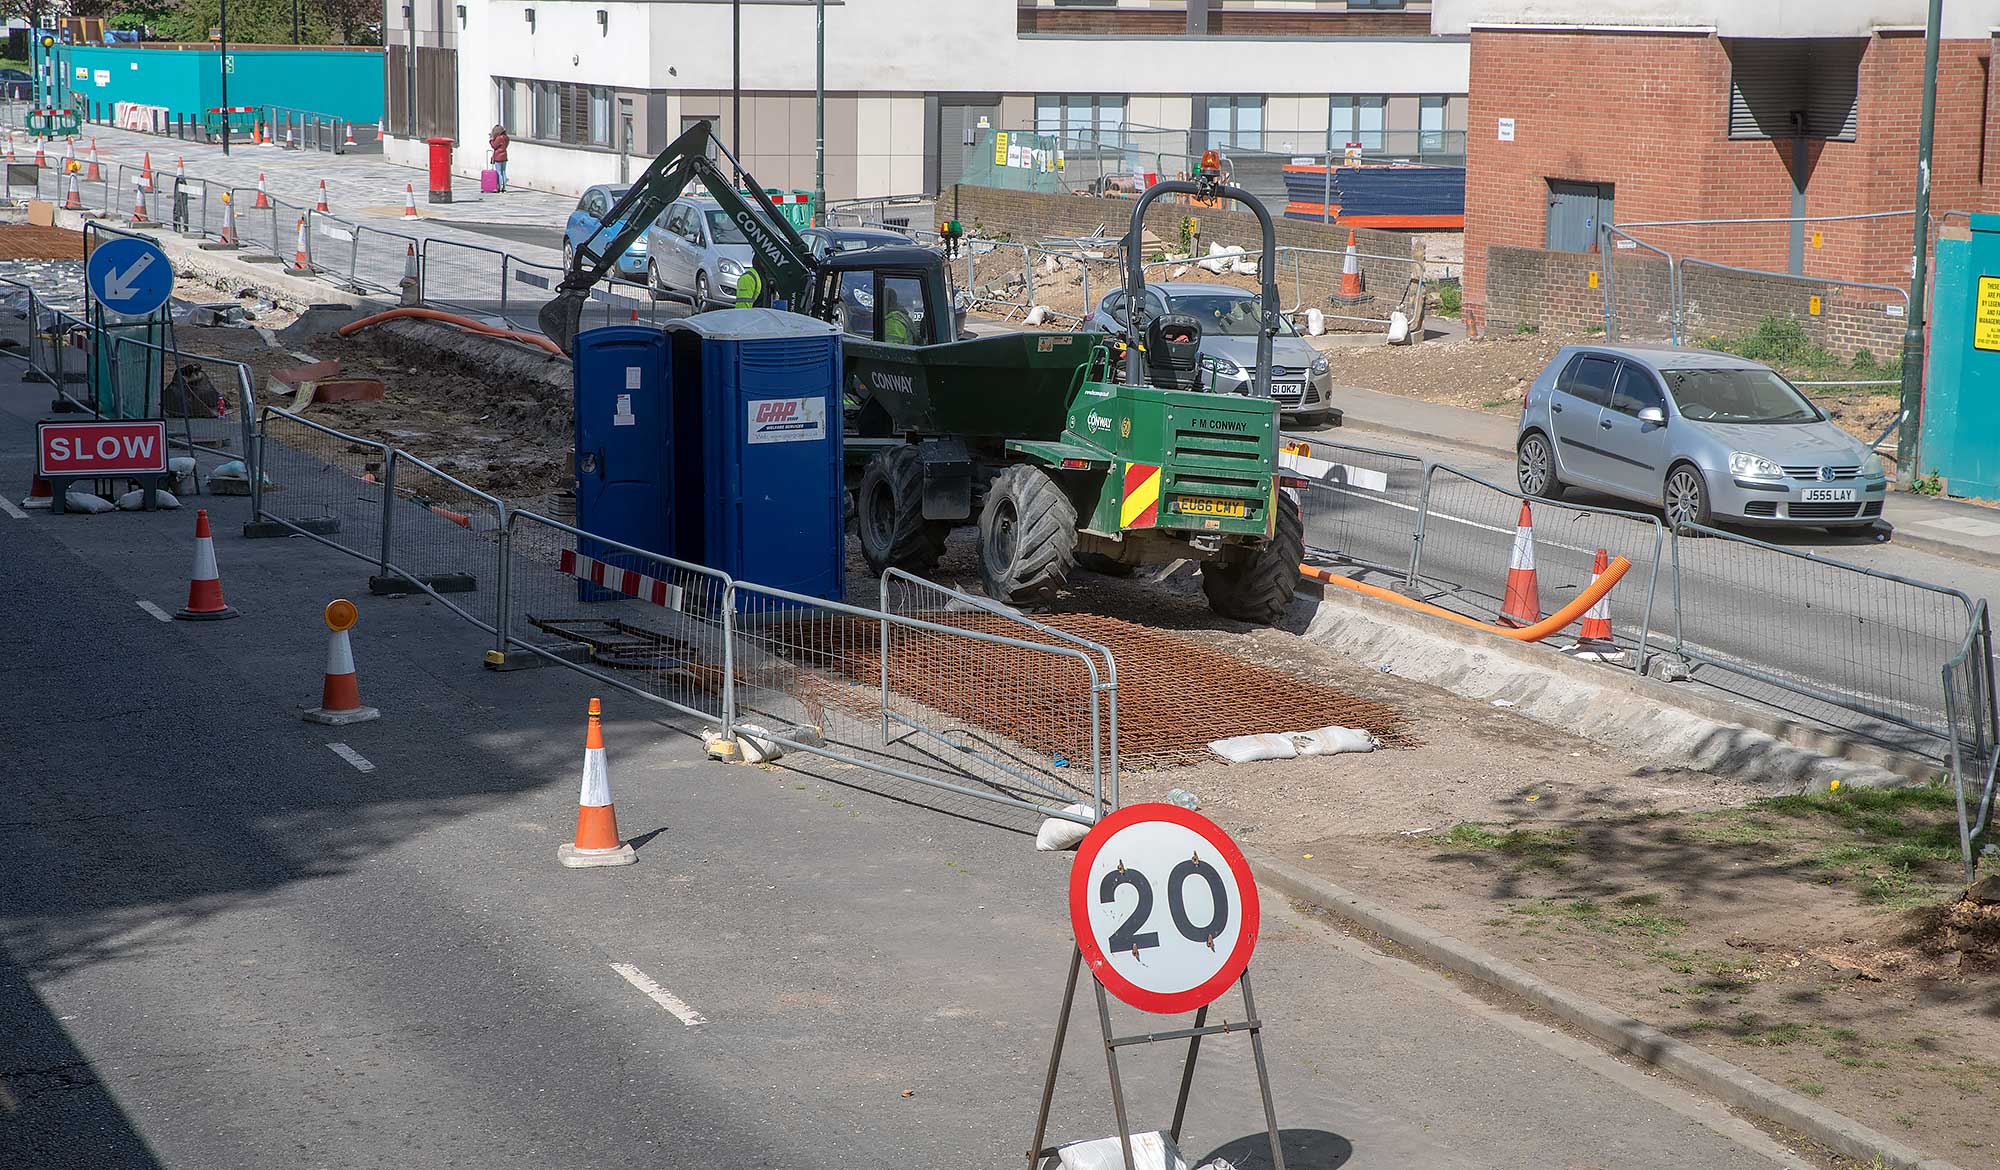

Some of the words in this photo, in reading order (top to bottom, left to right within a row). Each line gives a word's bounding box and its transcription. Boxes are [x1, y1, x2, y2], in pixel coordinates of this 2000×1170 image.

[736, 211, 790, 267] CONWAY
[871, 371, 913, 393] CONWAY
[1281, 385, 1297, 394] OKZ
[756, 402, 797, 423] GAP
[1087, 414, 1112, 429] CONWAY
[1191, 418, 1197, 428] F
[1199, 419, 1207, 428] M
[1209, 420, 1247, 432] CONWAY
[50, 435, 154, 461] SLOW
[1806, 490, 1832, 500] J555
[1833, 490, 1852, 500] LAY
[1181, 498, 1213, 512] EU66
[1100, 859, 1228, 953] 20
